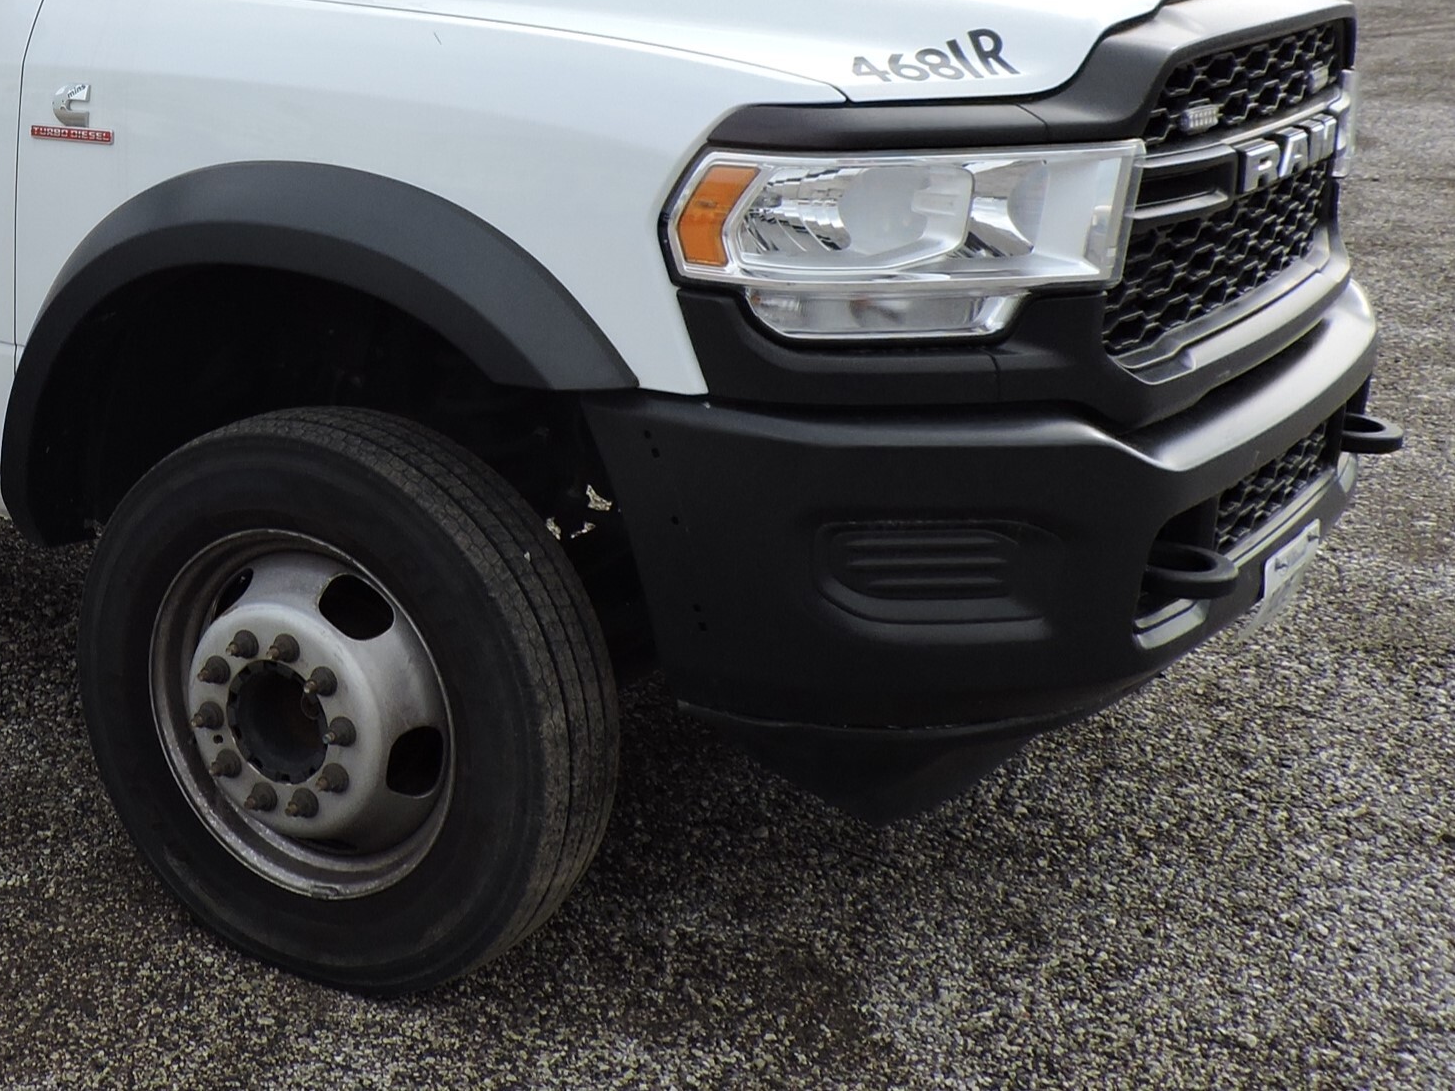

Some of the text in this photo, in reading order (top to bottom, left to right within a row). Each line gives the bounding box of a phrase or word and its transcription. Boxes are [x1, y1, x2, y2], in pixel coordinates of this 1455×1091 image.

[32, 125, 110, 141] TURBO DIESEL
[1243, 113, 1337, 193] RAM
